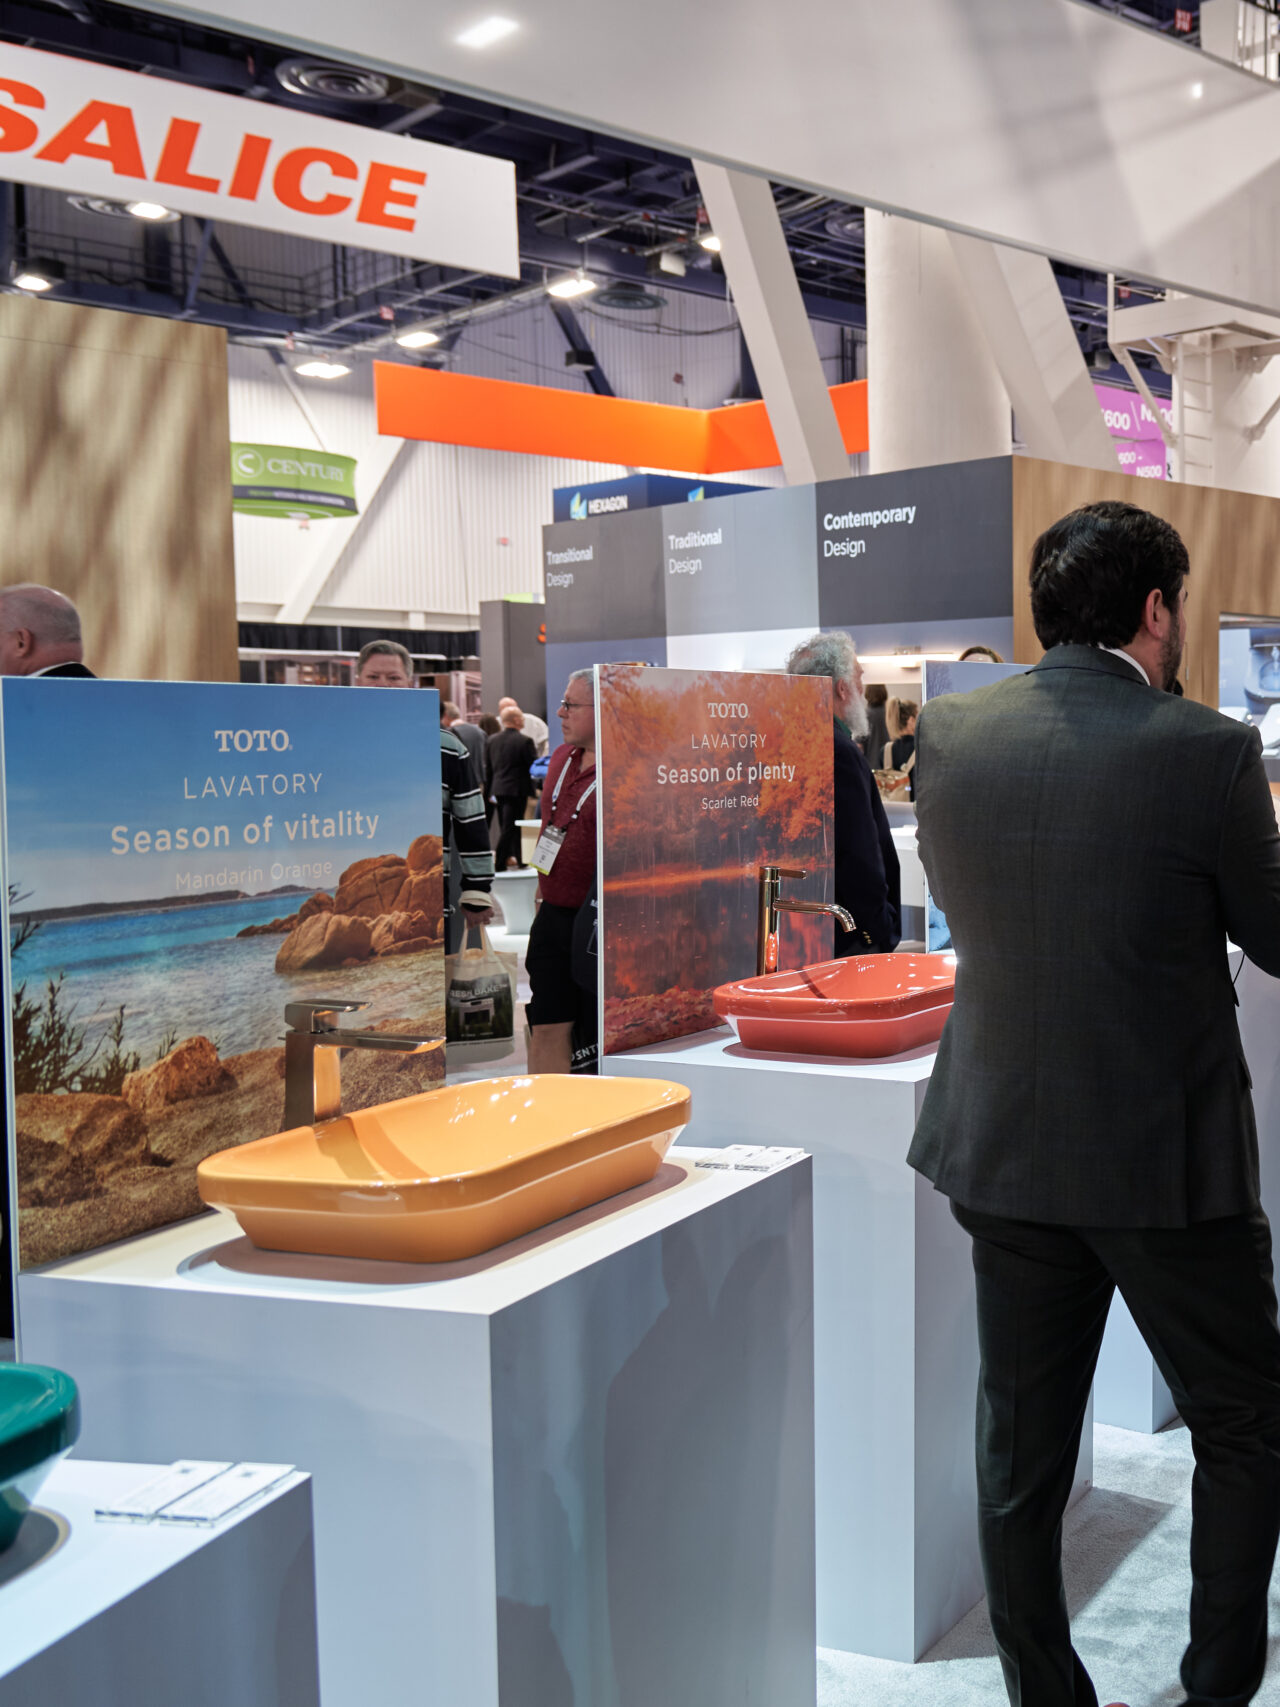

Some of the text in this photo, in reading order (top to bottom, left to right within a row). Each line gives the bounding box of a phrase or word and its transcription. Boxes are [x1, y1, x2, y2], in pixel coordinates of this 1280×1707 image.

[0, 78, 427, 232] SALICE
[1101, 408, 1131, 430] 600
[588, 495, 628, 514] HEXAGON
[823, 505, 916, 531] Contemporary
[668, 528, 722, 550] Traditional
[823, 537, 866, 558] Design
[546, 546, 593, 565] Transitional
[668, 556, 702, 575] Design
[546, 571, 574, 588] Design
[708, 702, 749, 719] TOTO
[214, 729, 291, 753] TOTO
[691, 734, 767, 749] LAVATORY
[657, 761, 796, 784] Season of plenty
[183, 773, 323, 800] LAVATORY
[702, 793, 759, 810] Scarlet Red
[111, 810, 380, 855] Season of vitality
[175, 860, 333, 890] Mandarin Orange
